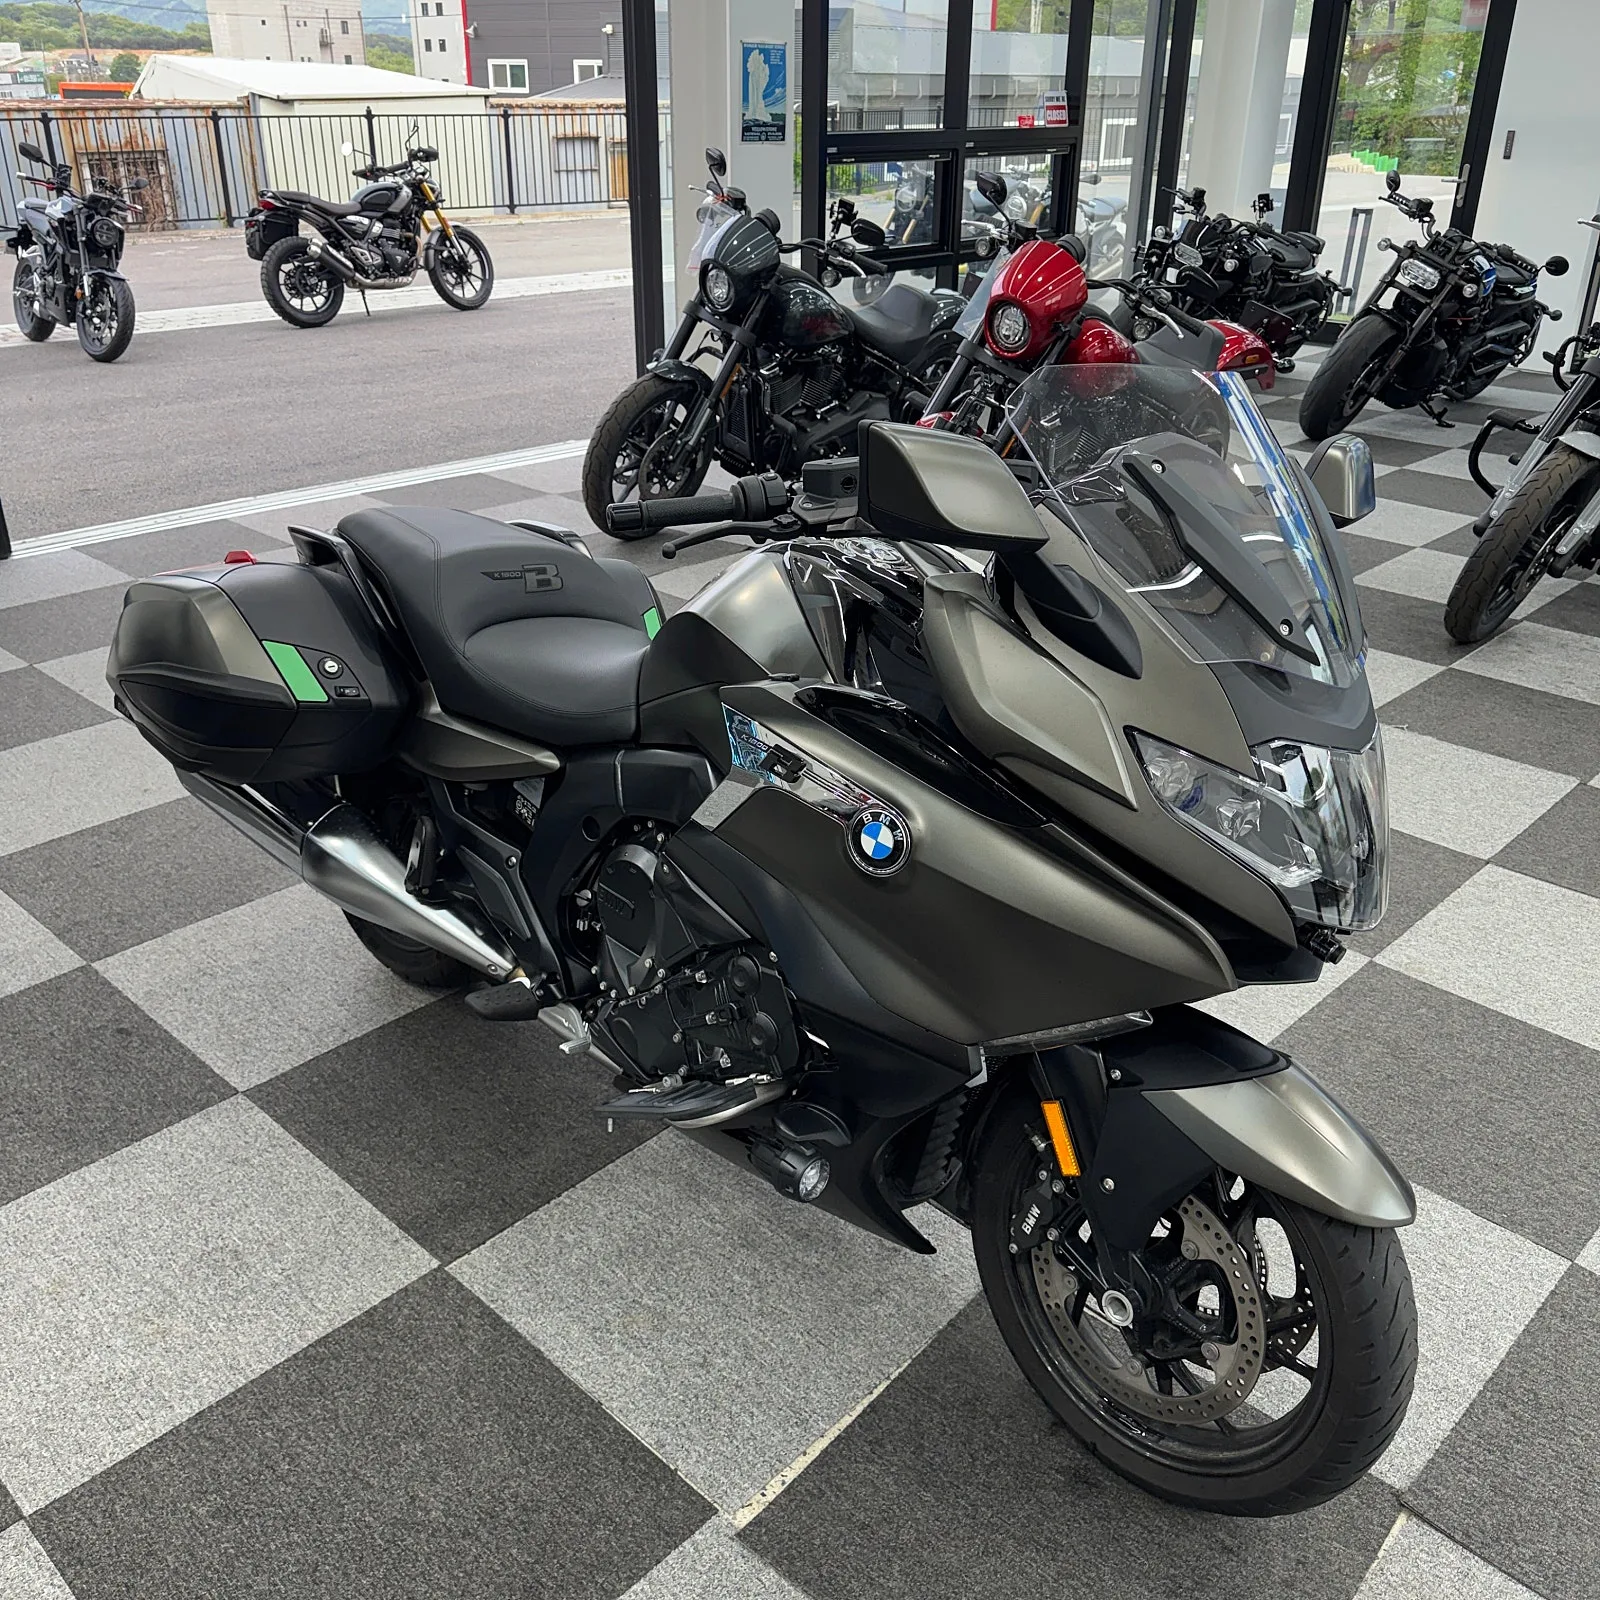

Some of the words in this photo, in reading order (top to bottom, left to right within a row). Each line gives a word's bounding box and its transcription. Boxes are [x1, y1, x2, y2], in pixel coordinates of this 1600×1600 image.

[1046, 109, 1067, 121] CLOSED
[521, 563, 564, 594] B
[862, 813, 904, 842] BMW
[1021, 1203, 1041, 1235] BMW
